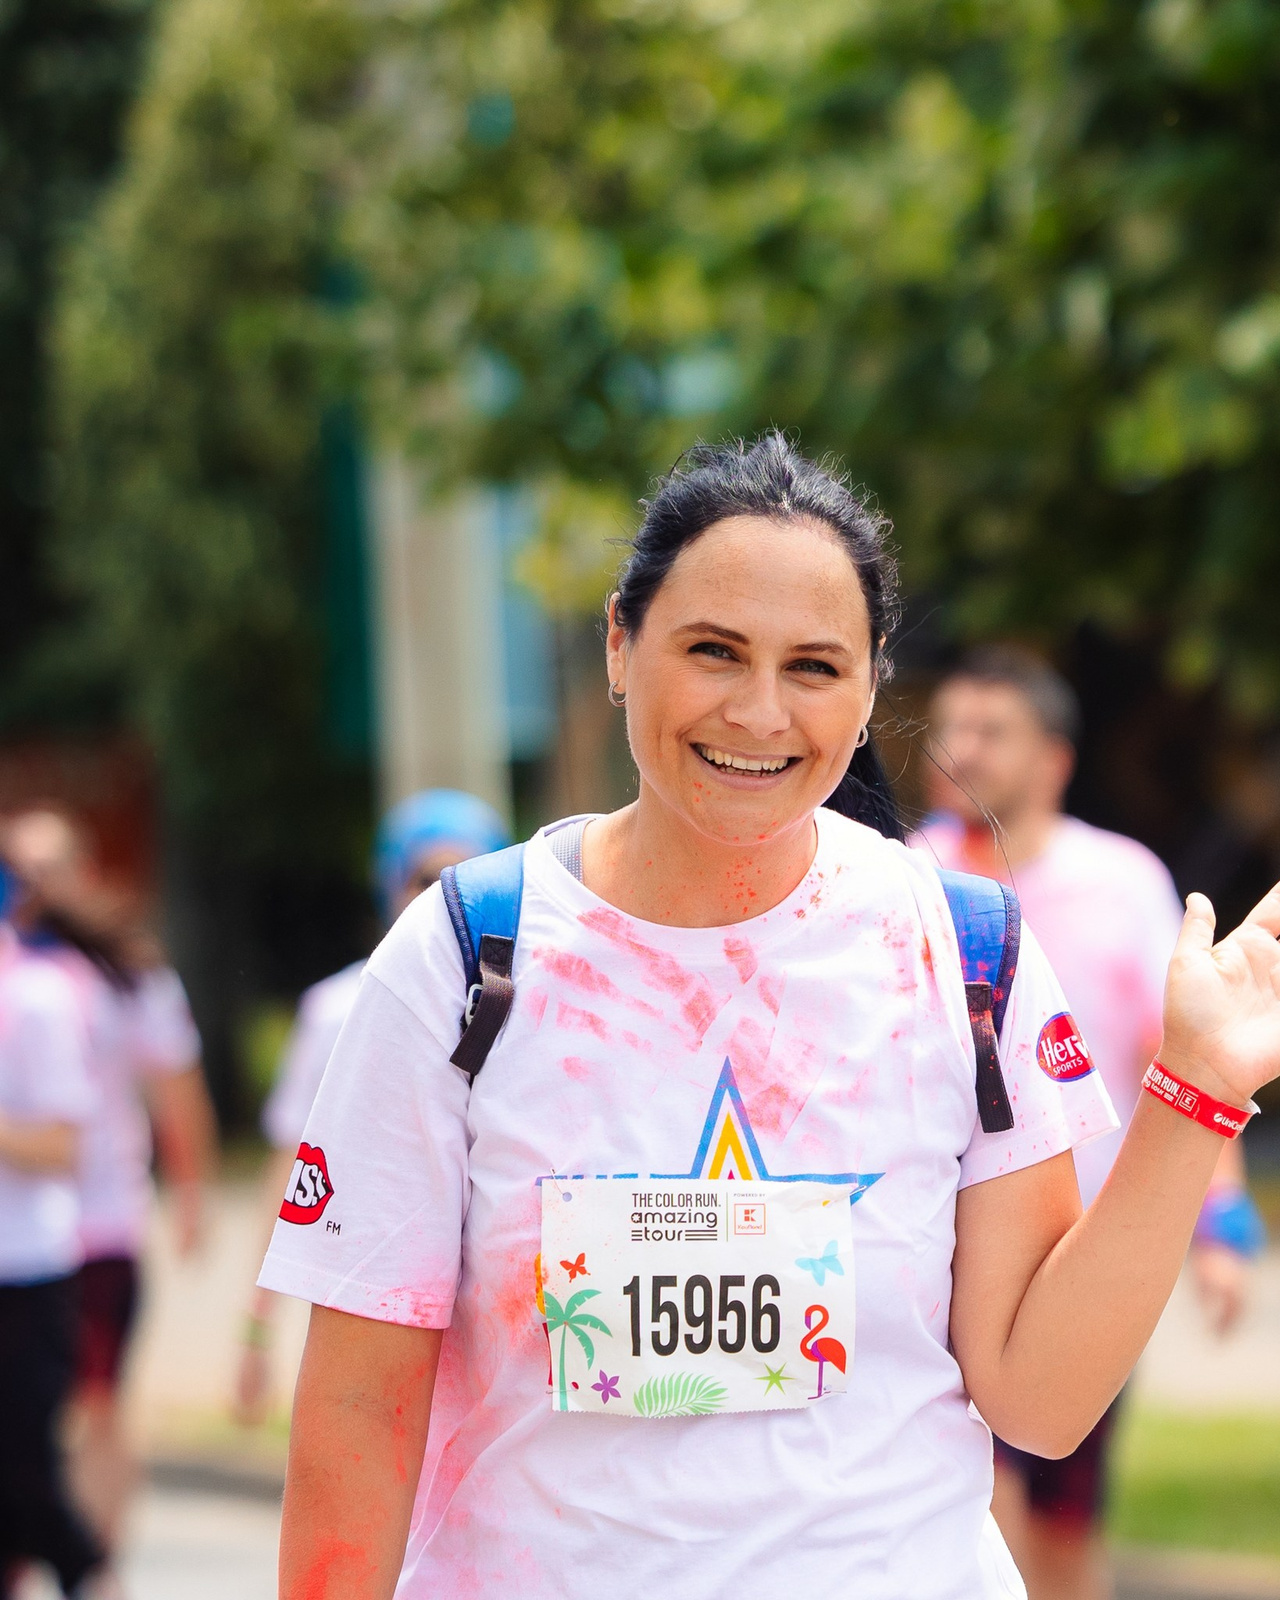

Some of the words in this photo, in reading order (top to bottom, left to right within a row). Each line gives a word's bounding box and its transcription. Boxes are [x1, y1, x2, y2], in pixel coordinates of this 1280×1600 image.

[1053, 1056, 1083, 1076] SPORTS
[1147, 1064, 1164, 1086] LOR
[632, 1193, 653, 1207] THE
[655, 1193, 693, 1207] COLOR
[326, 1221, 341, 1235] FM
[630, 1208, 718, 1228] amazing
[644, 1227, 682, 1241] tour
[623, 1274, 781, 1357] 15956
